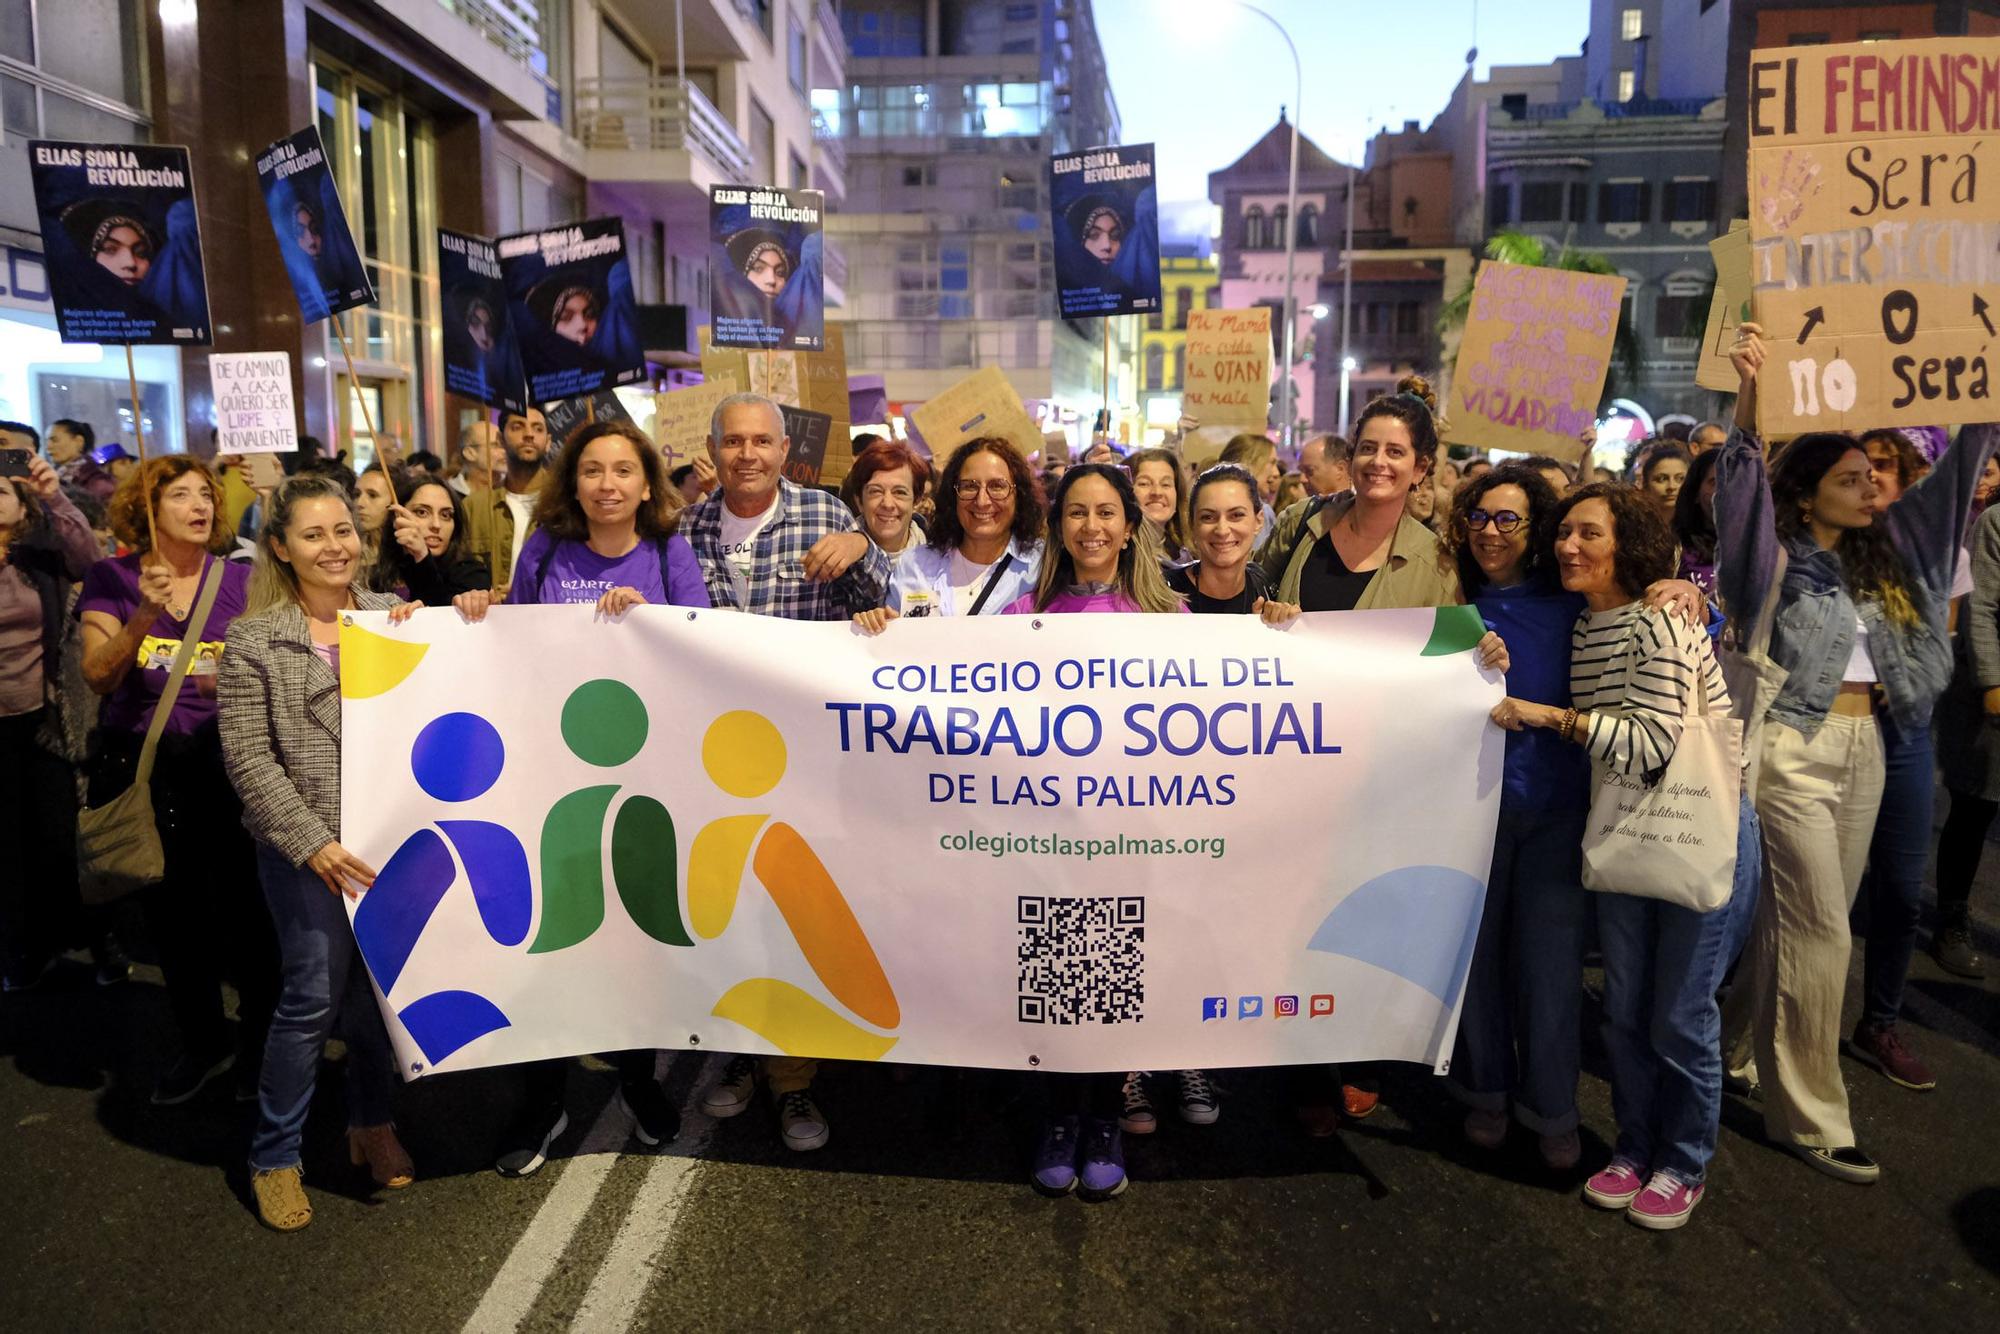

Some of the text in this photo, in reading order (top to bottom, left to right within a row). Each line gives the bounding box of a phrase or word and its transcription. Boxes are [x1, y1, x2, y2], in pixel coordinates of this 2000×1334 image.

[36, 147, 139, 169] ELLAS SON LA
[271, 146, 287, 166] SON
[284, 143, 298, 160] LA
[273, 147, 323, 181] REVOLUCIÓN
[1053, 152, 1120, 174] ELLAS SON LA
[86, 165, 185, 188] REVOLUCIÓN
[1084, 160, 1151, 184] REVOLUCIÓN
[1846, 140, 1983, 217] Será
[714, 189, 788, 207] ELLAS SON LA
[750, 204, 818, 223] REVOLUCIÓN
[441, 233, 497, 263] ELLAS SON LA
[215, 359, 285, 379] DE CAMINO
[1214, 359, 1262, 385] OTAN
[231, 380, 281, 394] A CASA
[221, 393, 289, 413] QUIERO SER
[228, 411, 265, 429] LIBRE
[872, 656, 1294, 694] COLEGIO OFICIAL DEL
[825, 702, 1342, 758] TRABAJO SOCIAL
[928, 773, 1237, 807] DE LAS PALMAS
[939, 830, 1226, 861] colegiotslaspalmas.org
